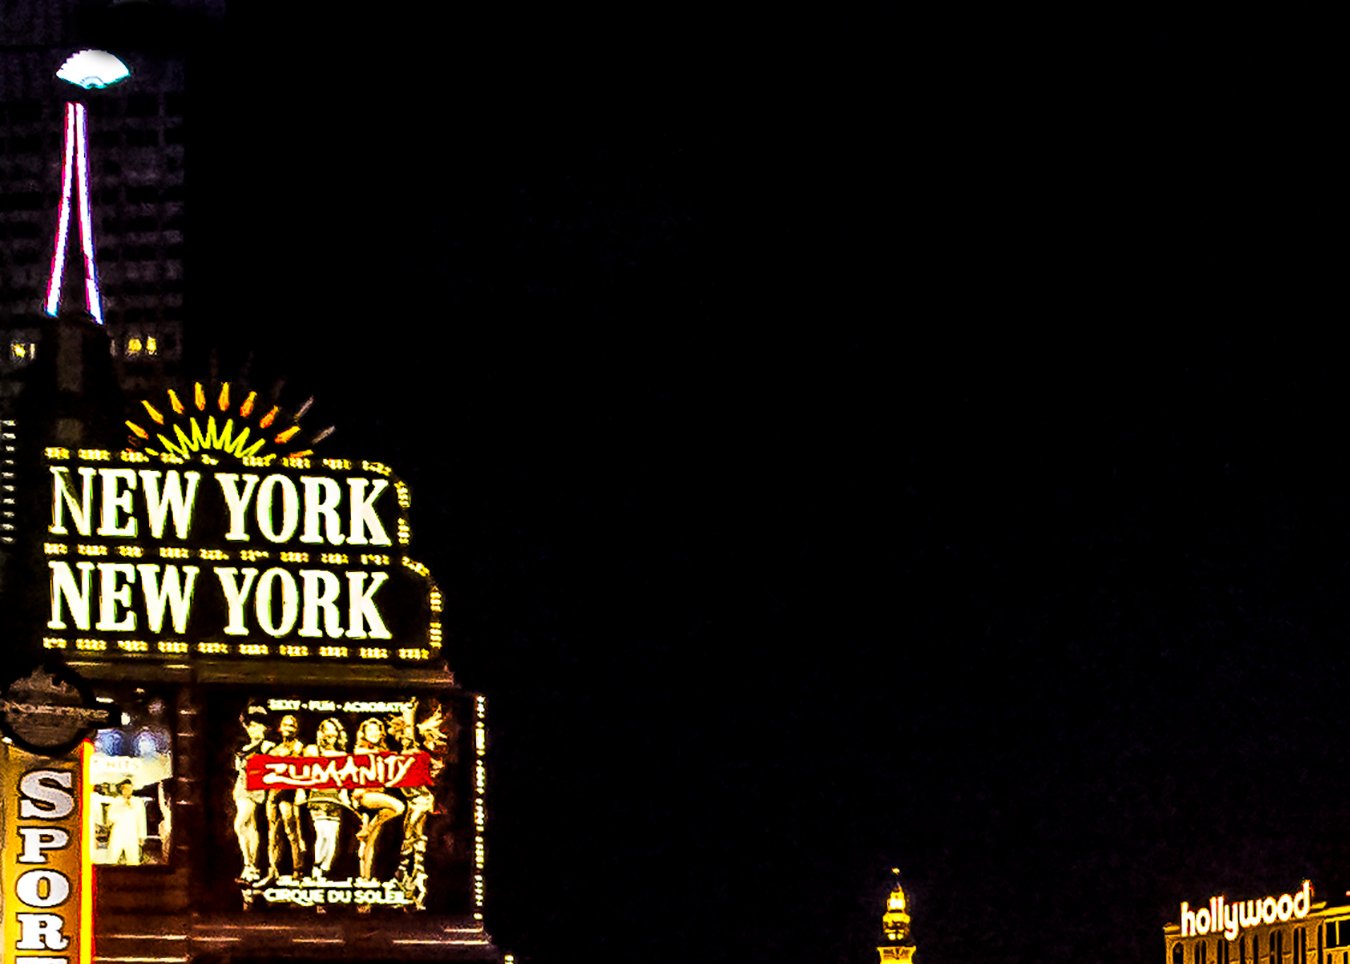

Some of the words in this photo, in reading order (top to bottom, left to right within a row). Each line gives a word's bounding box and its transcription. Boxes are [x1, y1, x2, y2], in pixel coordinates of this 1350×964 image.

[49, 466, 200, 539] NEW
[215, 473, 392, 547] YORK
[48, 561, 199, 634] NEW
[214, 567, 392, 640] YORK
[308, 700, 335, 711] FUN
[262, 753, 416, 787] ZUMANITY
[264, 888, 325, 906] CIRQUE
[327, 889, 352, 903] DU
[1181, 880, 1312, 940] hollywood
